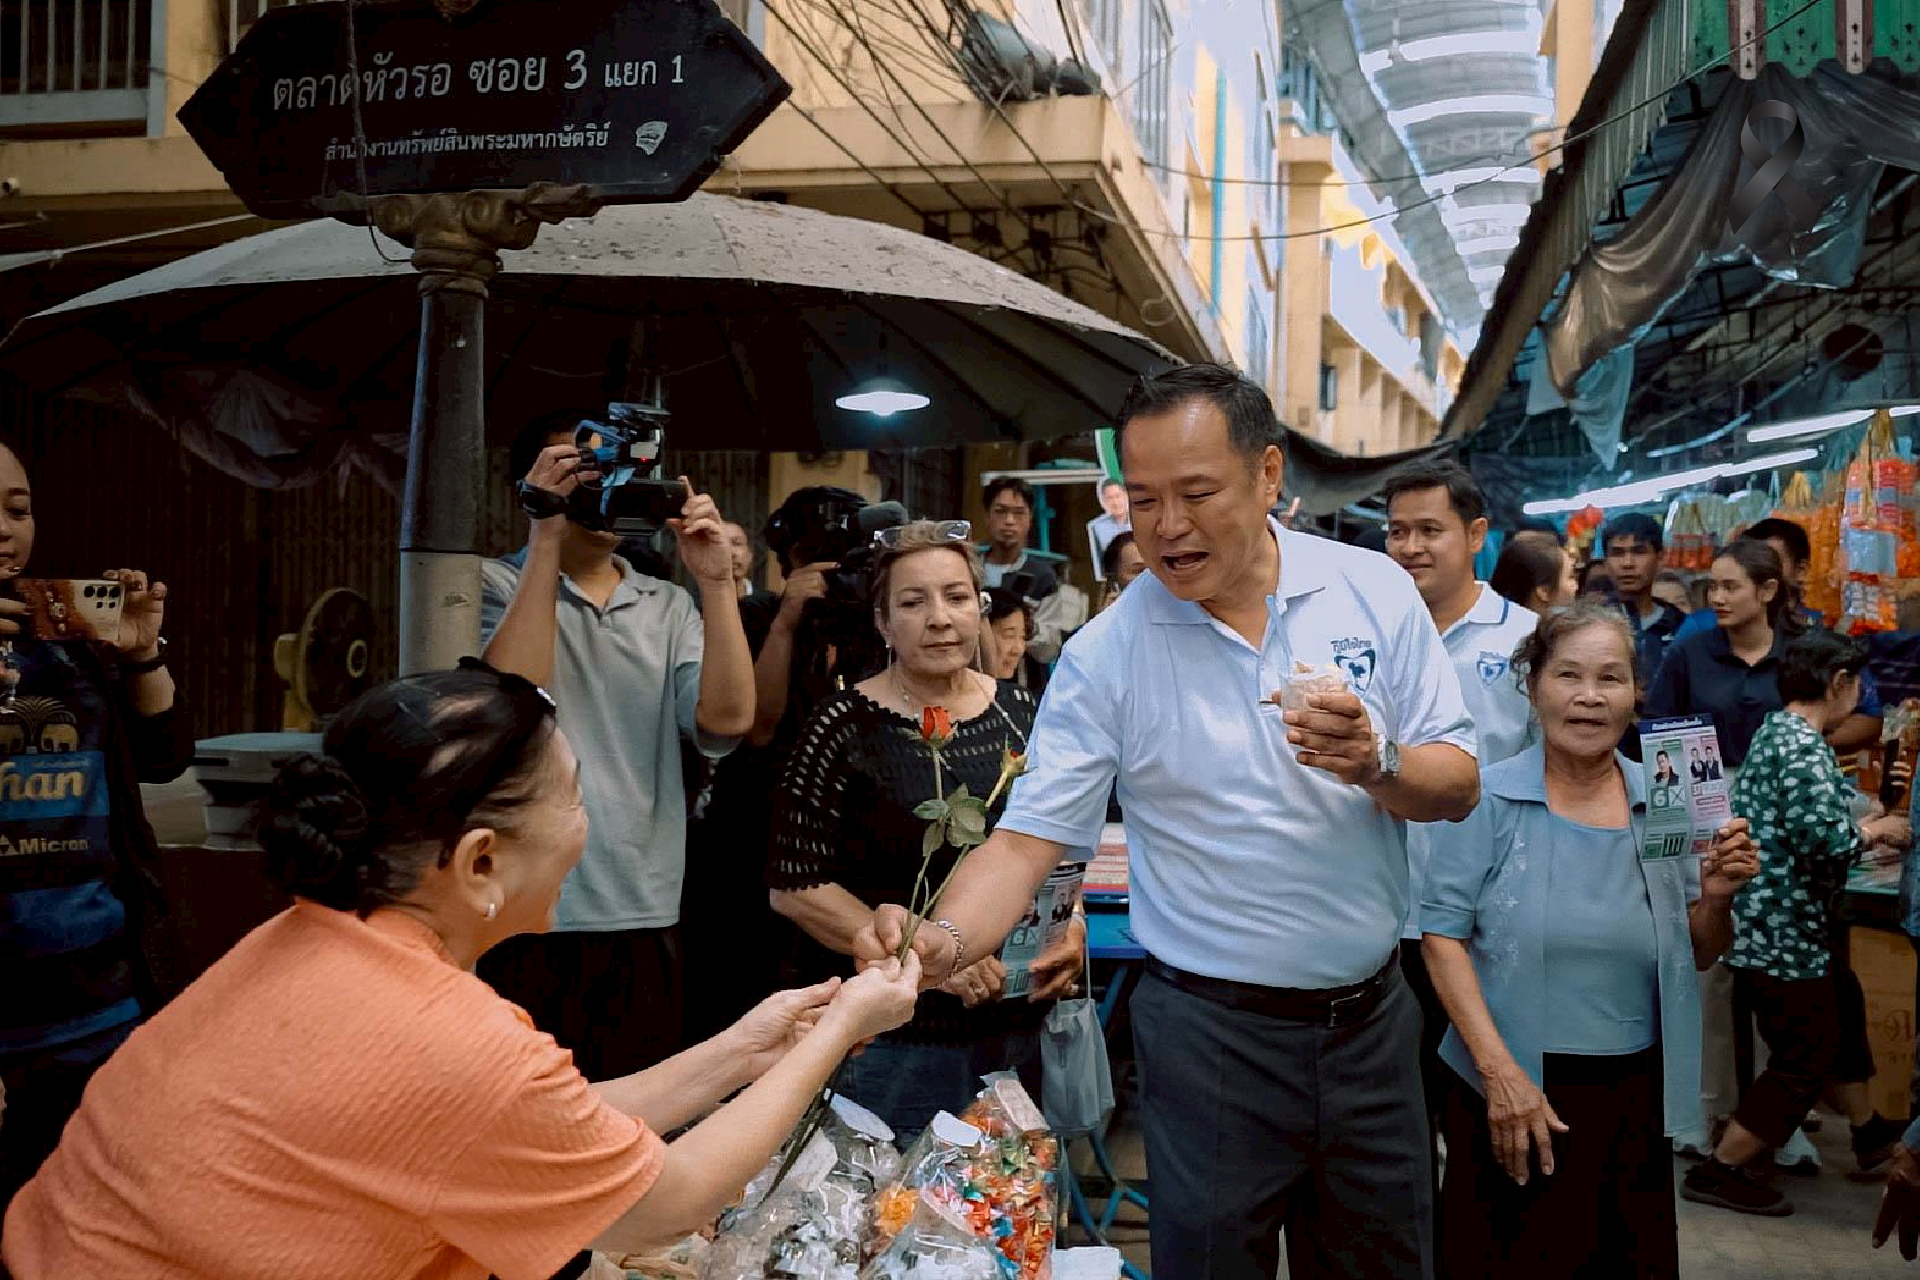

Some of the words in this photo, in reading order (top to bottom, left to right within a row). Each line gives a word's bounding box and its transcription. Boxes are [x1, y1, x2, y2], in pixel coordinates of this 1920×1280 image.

[273, 51, 452, 111] ตลาดหัวรอ
[469, 56, 547, 94] ซอย
[563, 49, 588, 90] 3
[604, 60, 657, 88] แยก
[671, 54, 684, 84] 1
[1654, 788, 1667, 807] 6
[18, 837, 89, 855] Micron
